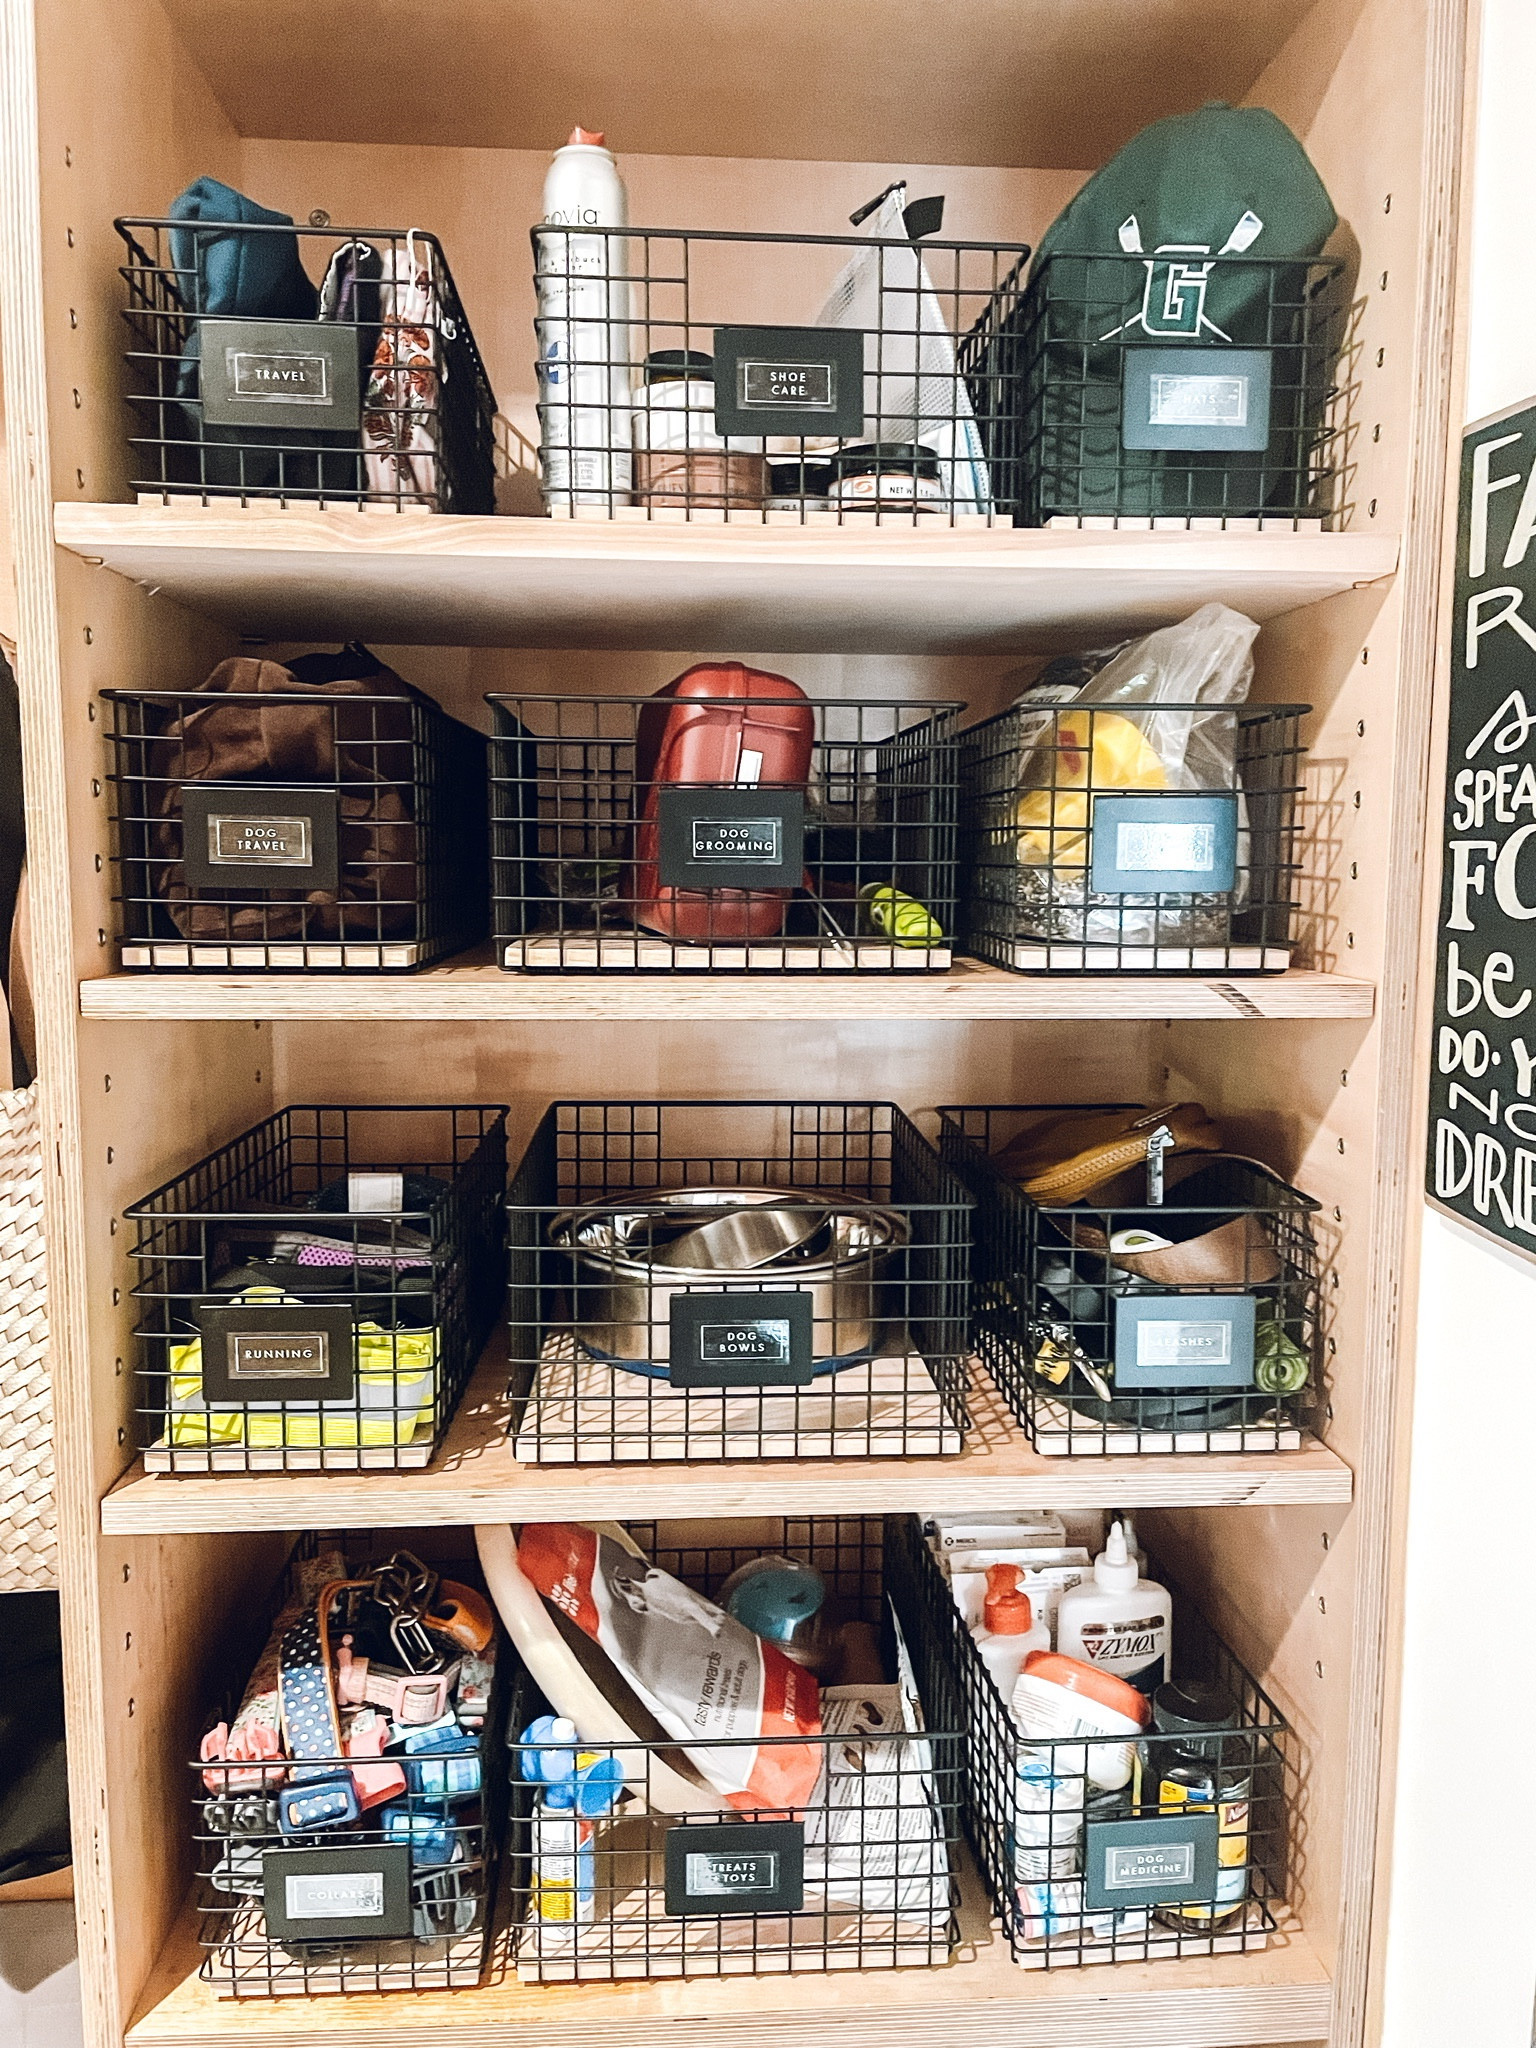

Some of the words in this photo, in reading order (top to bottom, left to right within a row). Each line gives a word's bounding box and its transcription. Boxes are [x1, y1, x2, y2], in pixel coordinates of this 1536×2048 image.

[1142, 244, 1210, 337] G
[254, 369, 306, 382] TRAVEL
[769, 371, 807, 383] SHOE
[770, 384, 807, 396] CARE
[244, 827, 277, 838] DOG
[719, 828, 749, 839] DOG
[236, 839, 287, 851] TRAVEL
[695, 840, 774, 851] GROOMING
[726, 1331, 757, 1341] DOG
[1159, 1336, 1213, 1347] LEASHES
[244, 1348, 313, 1359] RUNNING
[719, 1342, 765, 1353] BOWLS
[702, 1650, 722, 1699] rewards
[693, 1697, 713, 1727] tasty
[1136, 1854, 1165, 1865] DOG
[711, 1861, 757, 1873] TREATS
[1119, 1863, 1182, 1876] MEDICINE
[722, 1873, 756, 1883] TOYS
[306, 1889, 365, 1901] COLLARS
